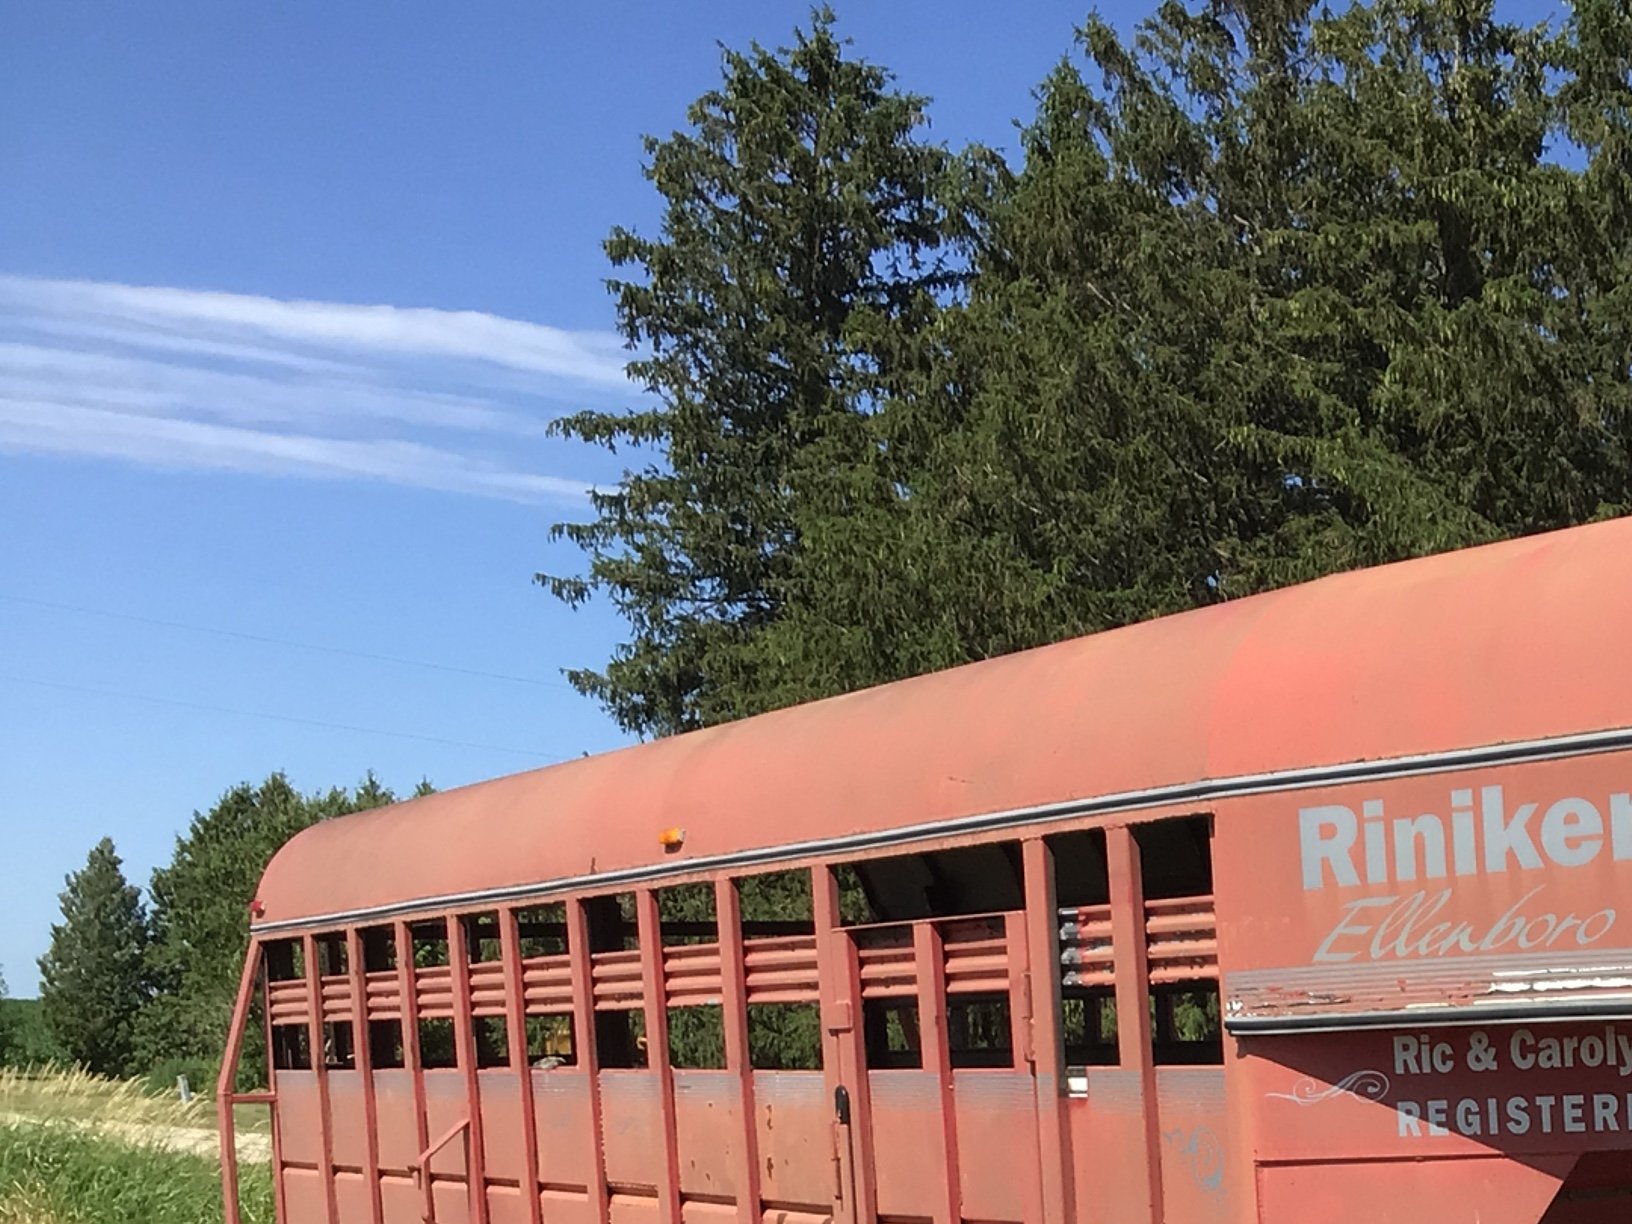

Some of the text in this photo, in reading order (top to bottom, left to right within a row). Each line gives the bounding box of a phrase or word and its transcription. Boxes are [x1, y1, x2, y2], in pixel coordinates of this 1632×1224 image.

[1311, 886, 1618, 963] Ellenboro
[1393, 1032, 1453, 1075] Ric
[1466, 1030, 1498, 1072] &
